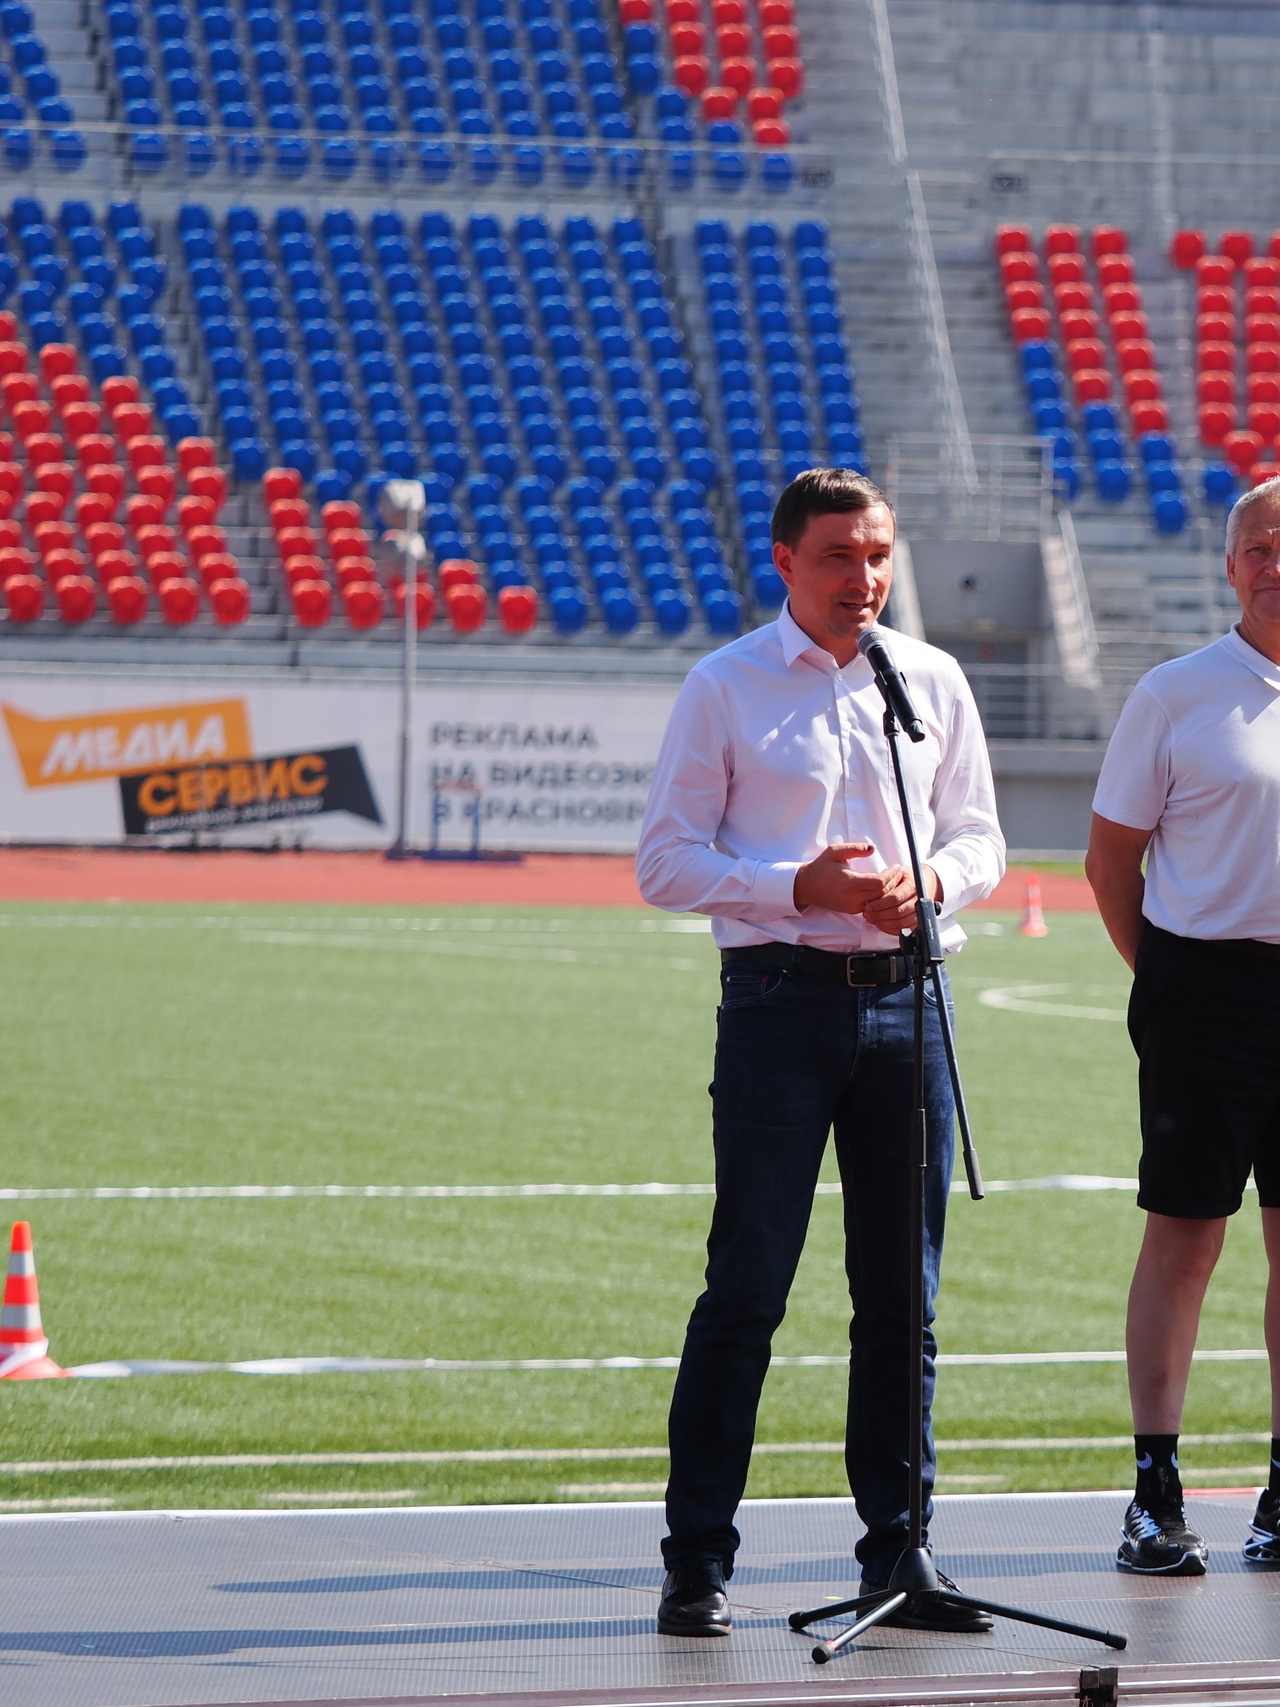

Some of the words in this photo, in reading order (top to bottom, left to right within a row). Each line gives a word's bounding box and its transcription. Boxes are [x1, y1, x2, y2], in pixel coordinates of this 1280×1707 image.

[39, 712, 228, 778] МЕДИА
[430, 722, 599, 749] РЕКЛАМА
[138, 754, 329, 818] СЕРВИС
